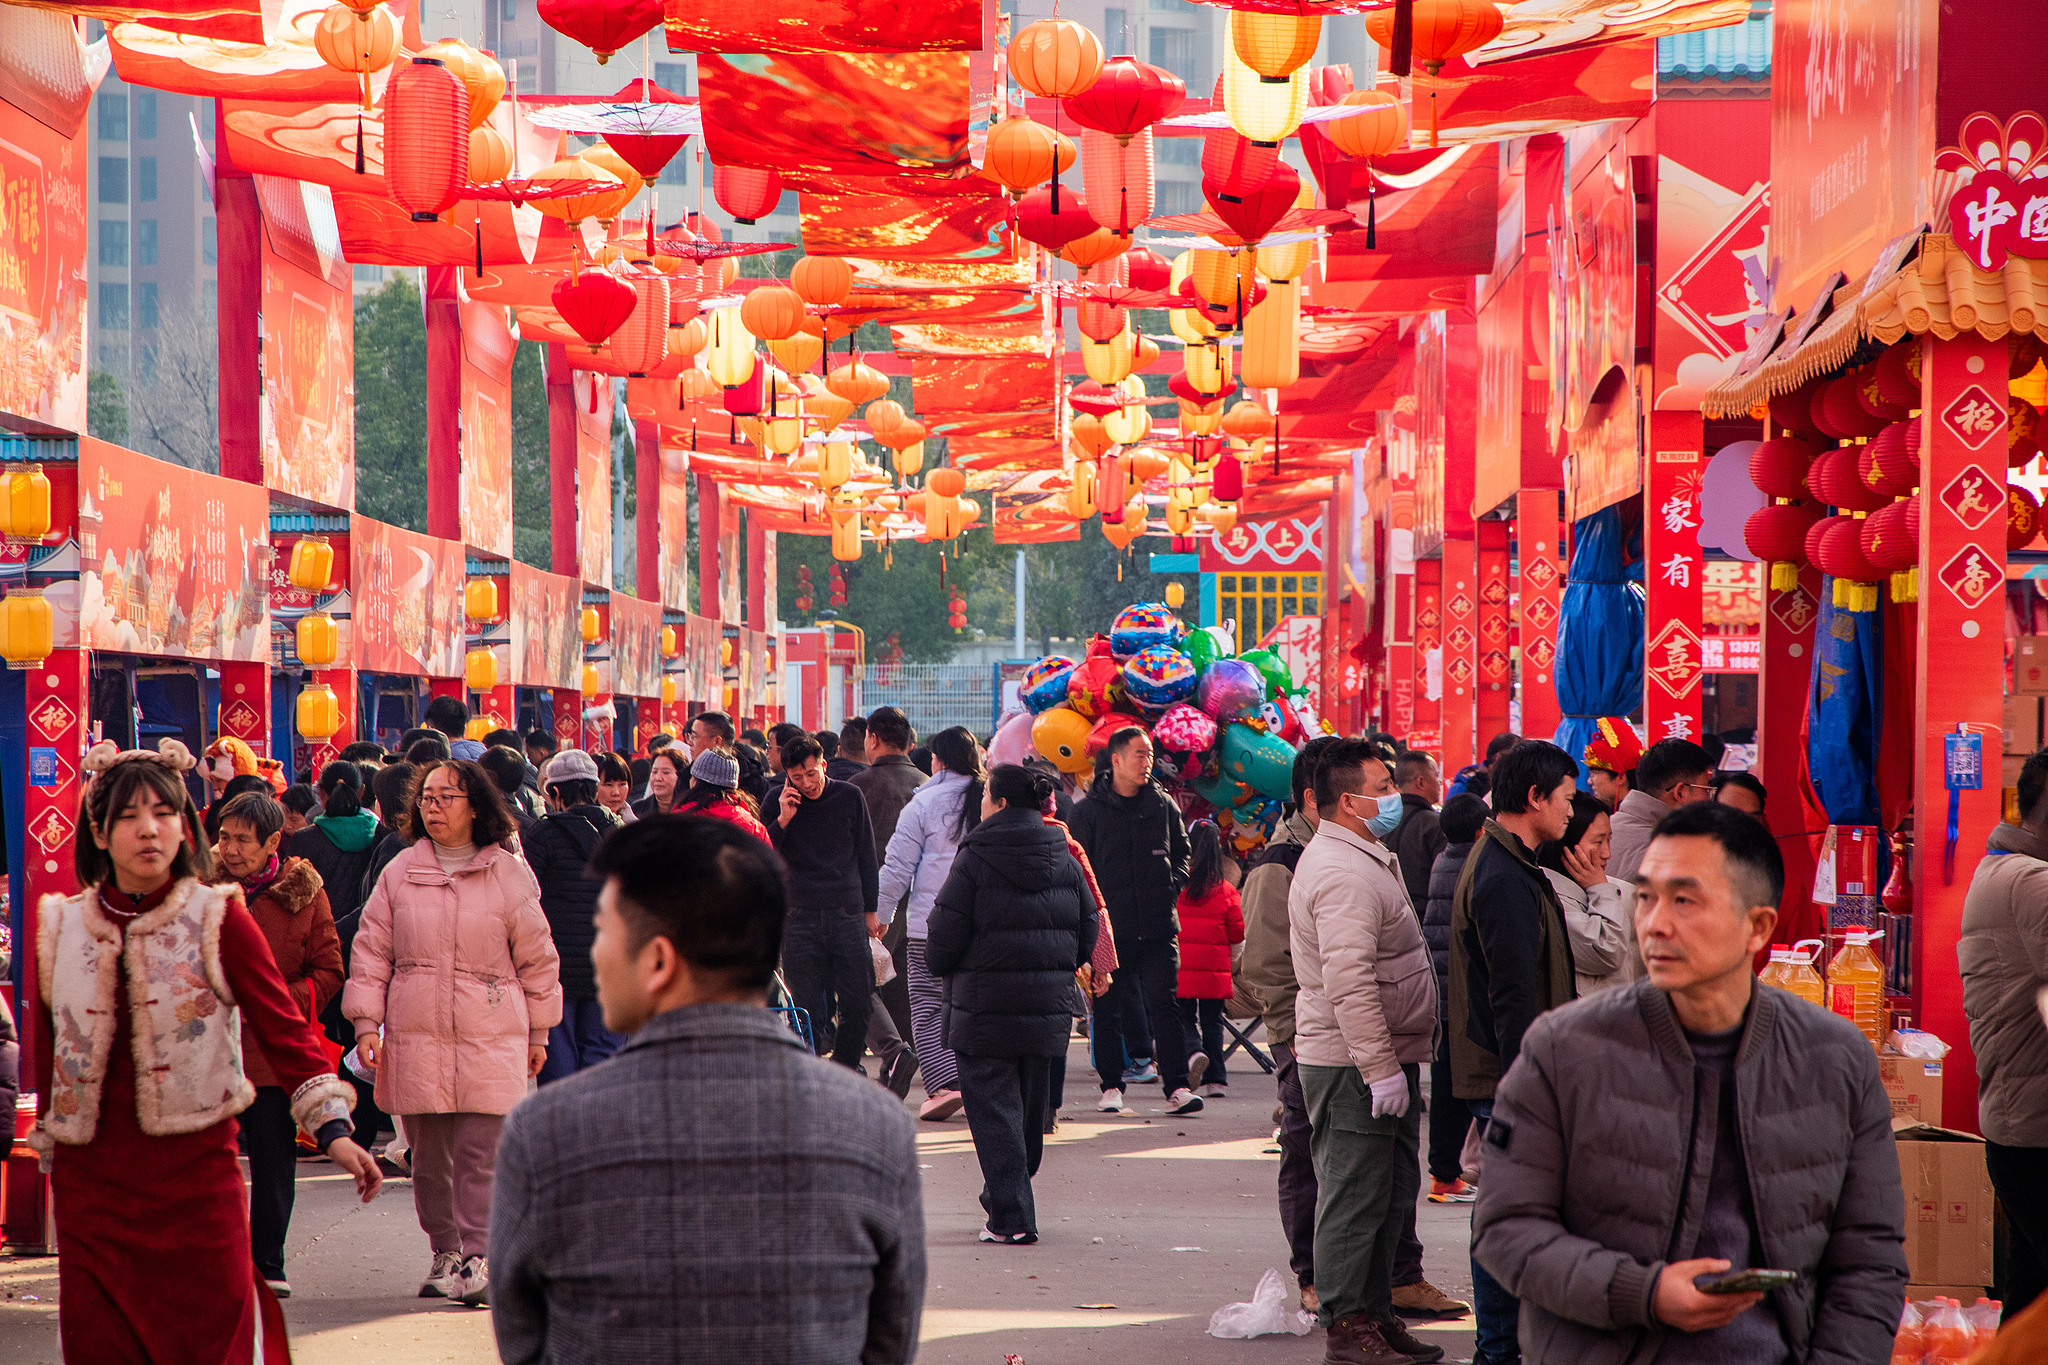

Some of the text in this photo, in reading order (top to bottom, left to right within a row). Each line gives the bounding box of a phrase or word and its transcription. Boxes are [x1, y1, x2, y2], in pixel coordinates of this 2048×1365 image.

[1952, 399, 1995, 599] 稻花香
[1396, 680, 1411, 740] HAPP
[1655, 497, 1700, 740] 家有喜事
